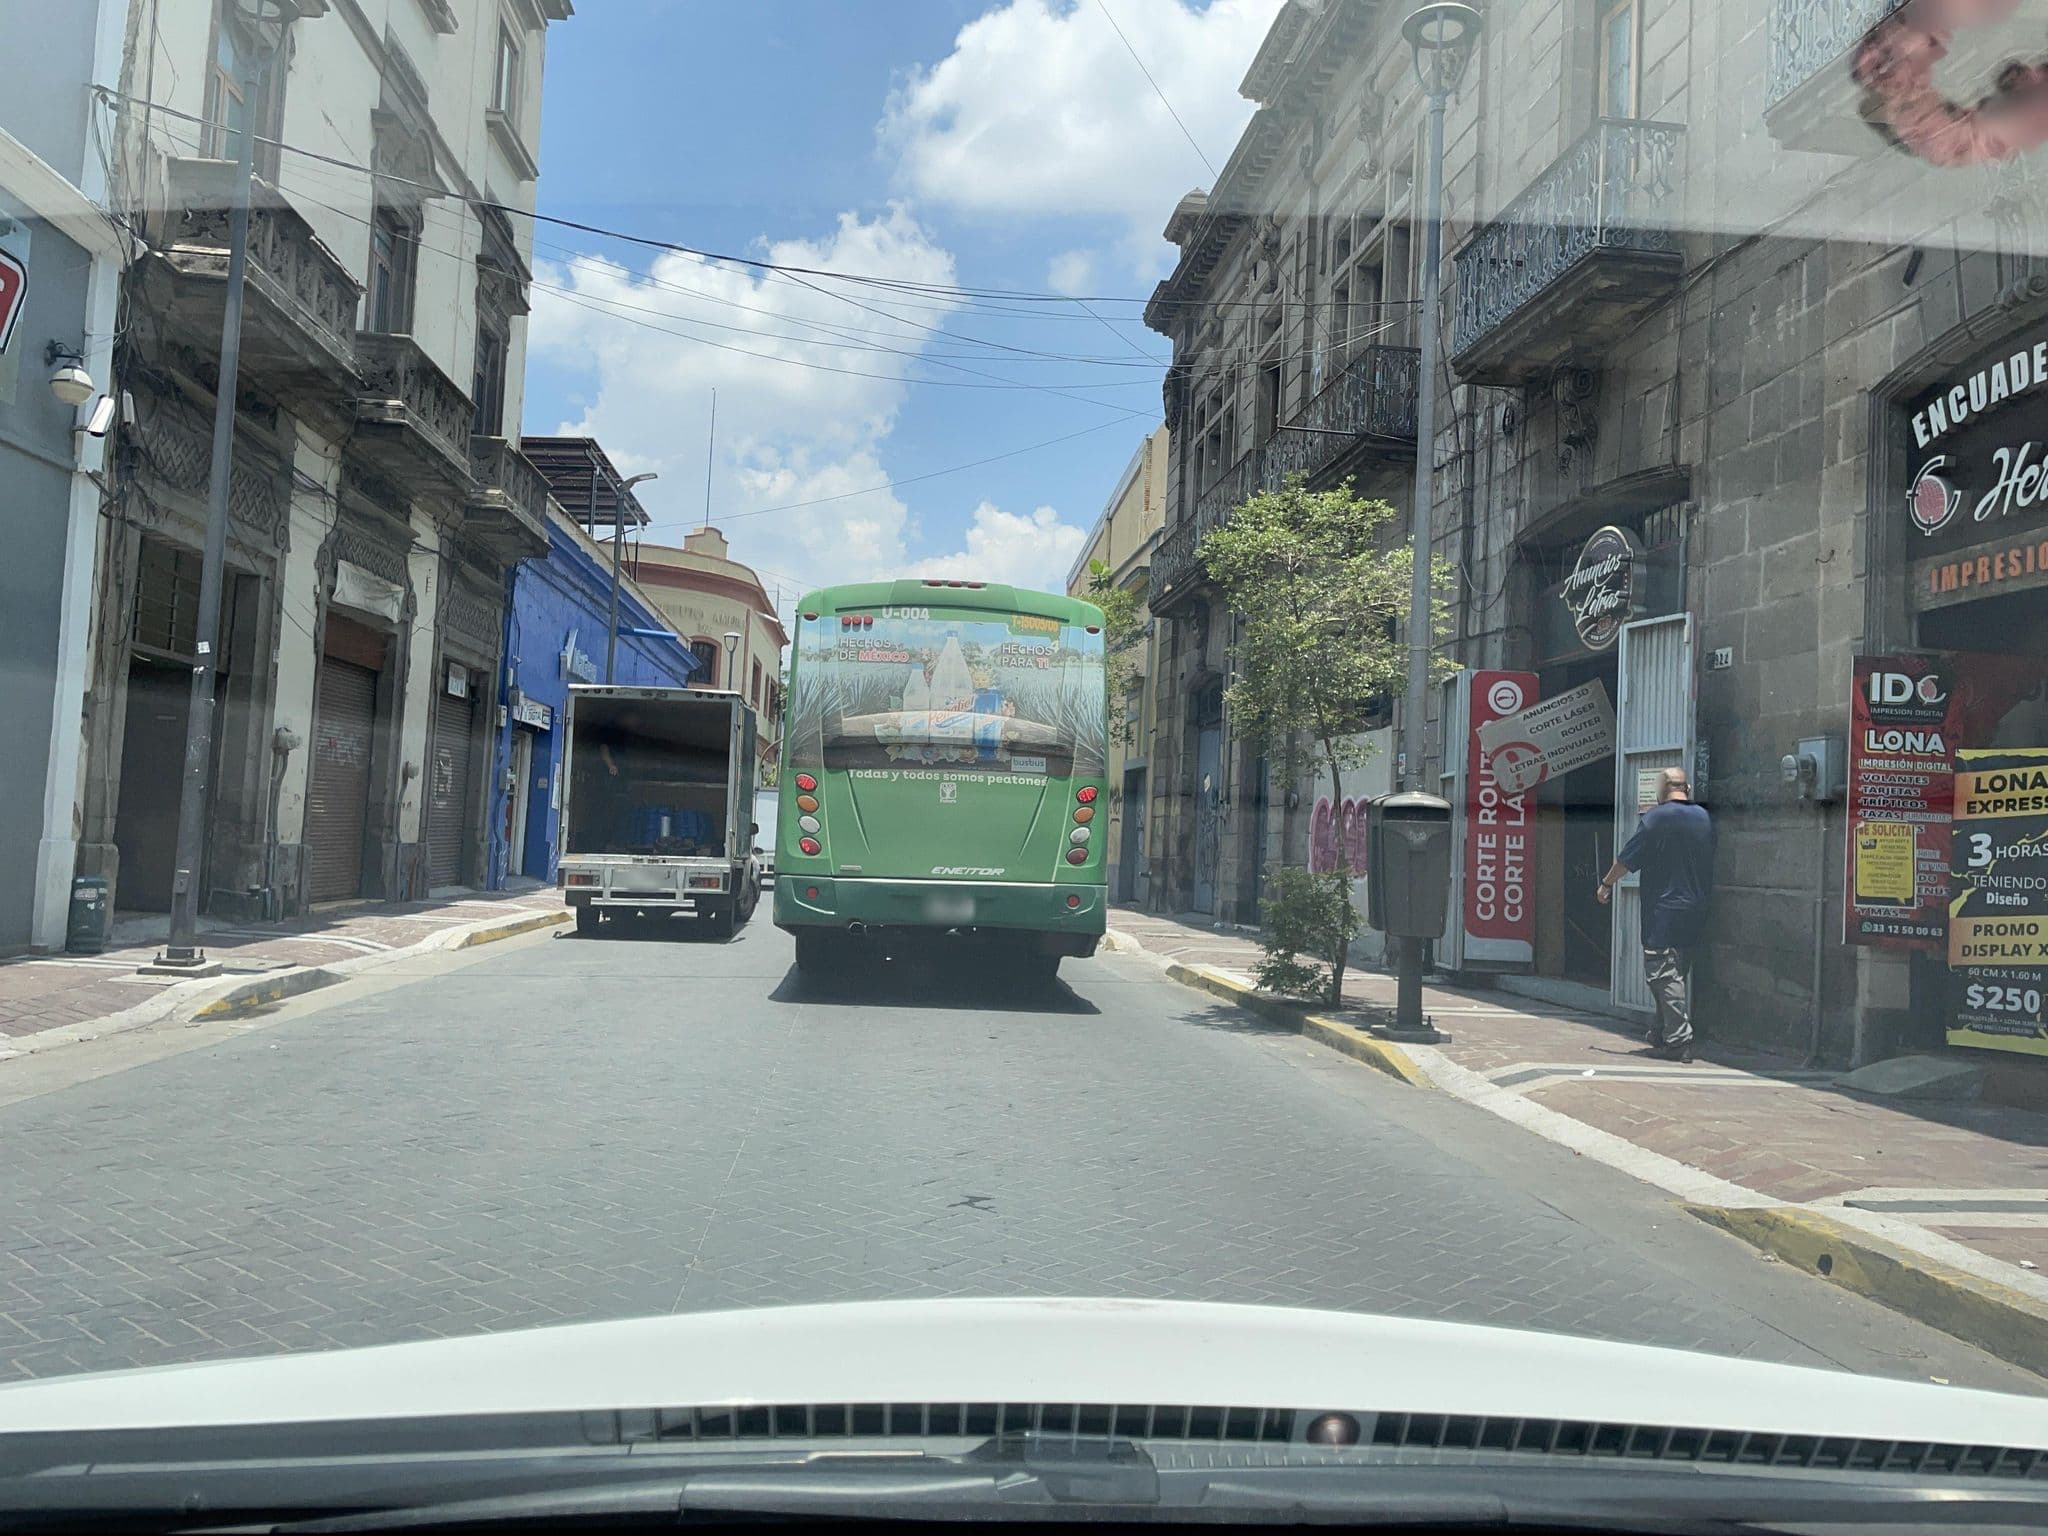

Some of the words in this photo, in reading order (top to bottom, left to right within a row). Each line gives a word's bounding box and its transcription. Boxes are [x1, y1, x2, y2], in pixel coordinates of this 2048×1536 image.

[1912, 341, 2048, 449] ENCUADE
[1559, 553, 1621, 599] Anuncios
[882, 607, 930, 620] U-004
[1575, 585, 1620, 627] Letras
[840, 638, 891, 648] HECHOS
[1002, 643, 1053, 656] HECHOS
[839, 650, 857, 661] DE
[858, 648, 910, 663] MÉXICO
[1002, 656, 1034, 668] PARA
[1036, 657, 1049, 669] TI
[1523, 694, 1574, 720] ANUNCIOS
[1575, 688, 1589, 699] 3D
[1529, 718, 1562, 734] CORTE
[1564, 702, 1596, 720] LÁSER
[1915, 709, 1944, 718] DIGITAL
[1561, 717, 1601, 738] ROUTER
[1866, 730, 1946, 755] LONA
[1509, 753, 1546, 774] LETRAS
[1547, 730, 1607, 758] INDIVUALES
[1551, 744, 1611, 773] LUMINOSOS
[1916, 760, 1953, 772] DIGITAL
[847, 769, 889, 779] Todas
[891, 771, 900, 782] y
[903, 769, 940, 780] todos
[943, 773, 984, 782] somos
[987, 774, 1048, 786] peatones
[1863, 774, 1929, 785] VOLANTES
[1974, 771, 2048, 795] LONA
[1478, 753, 1498, 826] ROUT
[1862, 785, 1920, 796] TARJETAS
[1862, 797, 1927, 809] TRÍPTICOS
[1861, 809, 1901, 820] TAZAS
[1872, 824, 1912, 837] SOLICITA
[1968, 833, 1992, 867] 3
[1996, 842, 2048, 859] HORAS
[931, 866, 1005, 876] ENEITOR
[1476, 833, 1497, 921] CORTE
[1503, 834, 1525, 922] CORTE
[1972, 874, 2047, 890] TENIENDO
[1986, 891, 2029, 906] Diseño
[1888, 924, 1899, 934] 12
[1902, 925, 1914, 935] 50
[1973, 922, 2040, 937] PROMO
[1961, 944, 2033, 957] DISPLAY
[1982, 968, 1998, 978] CM
[2001, 970, 2008, 979] X
[2032, 972, 2042, 982] M
[1966, 983, 2041, 1014] $250
